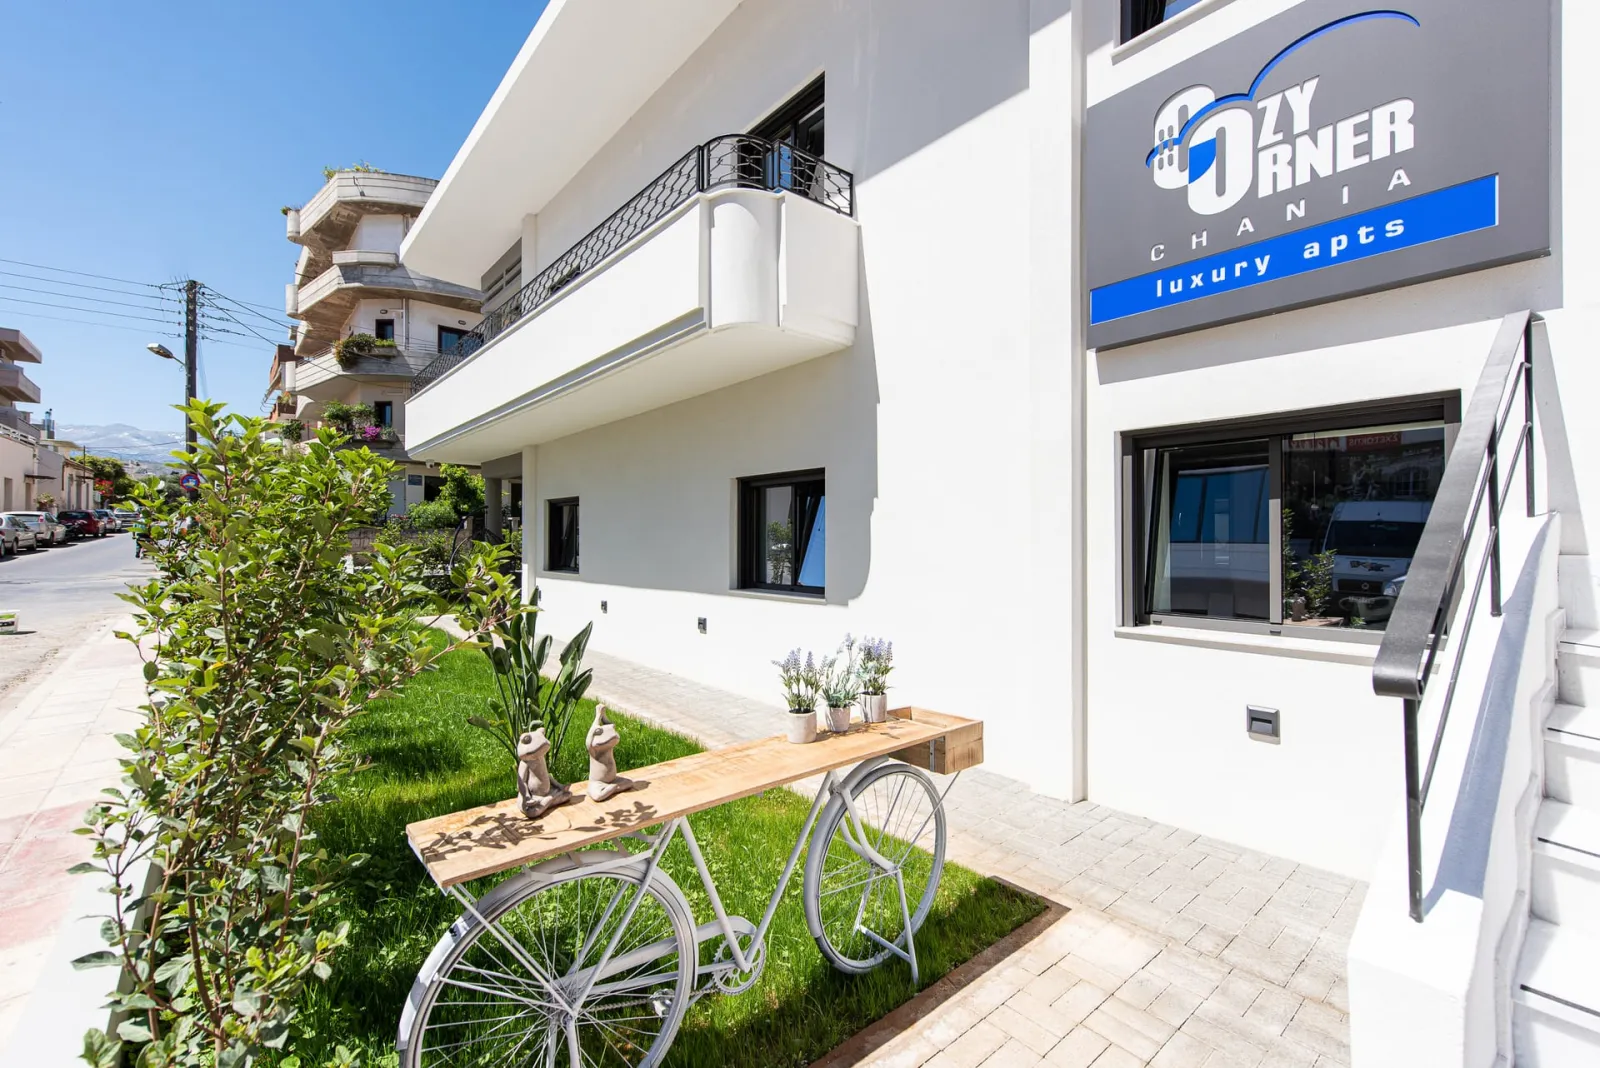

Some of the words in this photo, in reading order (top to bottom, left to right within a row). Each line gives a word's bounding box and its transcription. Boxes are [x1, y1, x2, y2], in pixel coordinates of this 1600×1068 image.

[1150, 167, 1412, 262] CHANIA
[1155, 254, 1271, 298] luxury
[1302, 217, 1405, 259] apts
